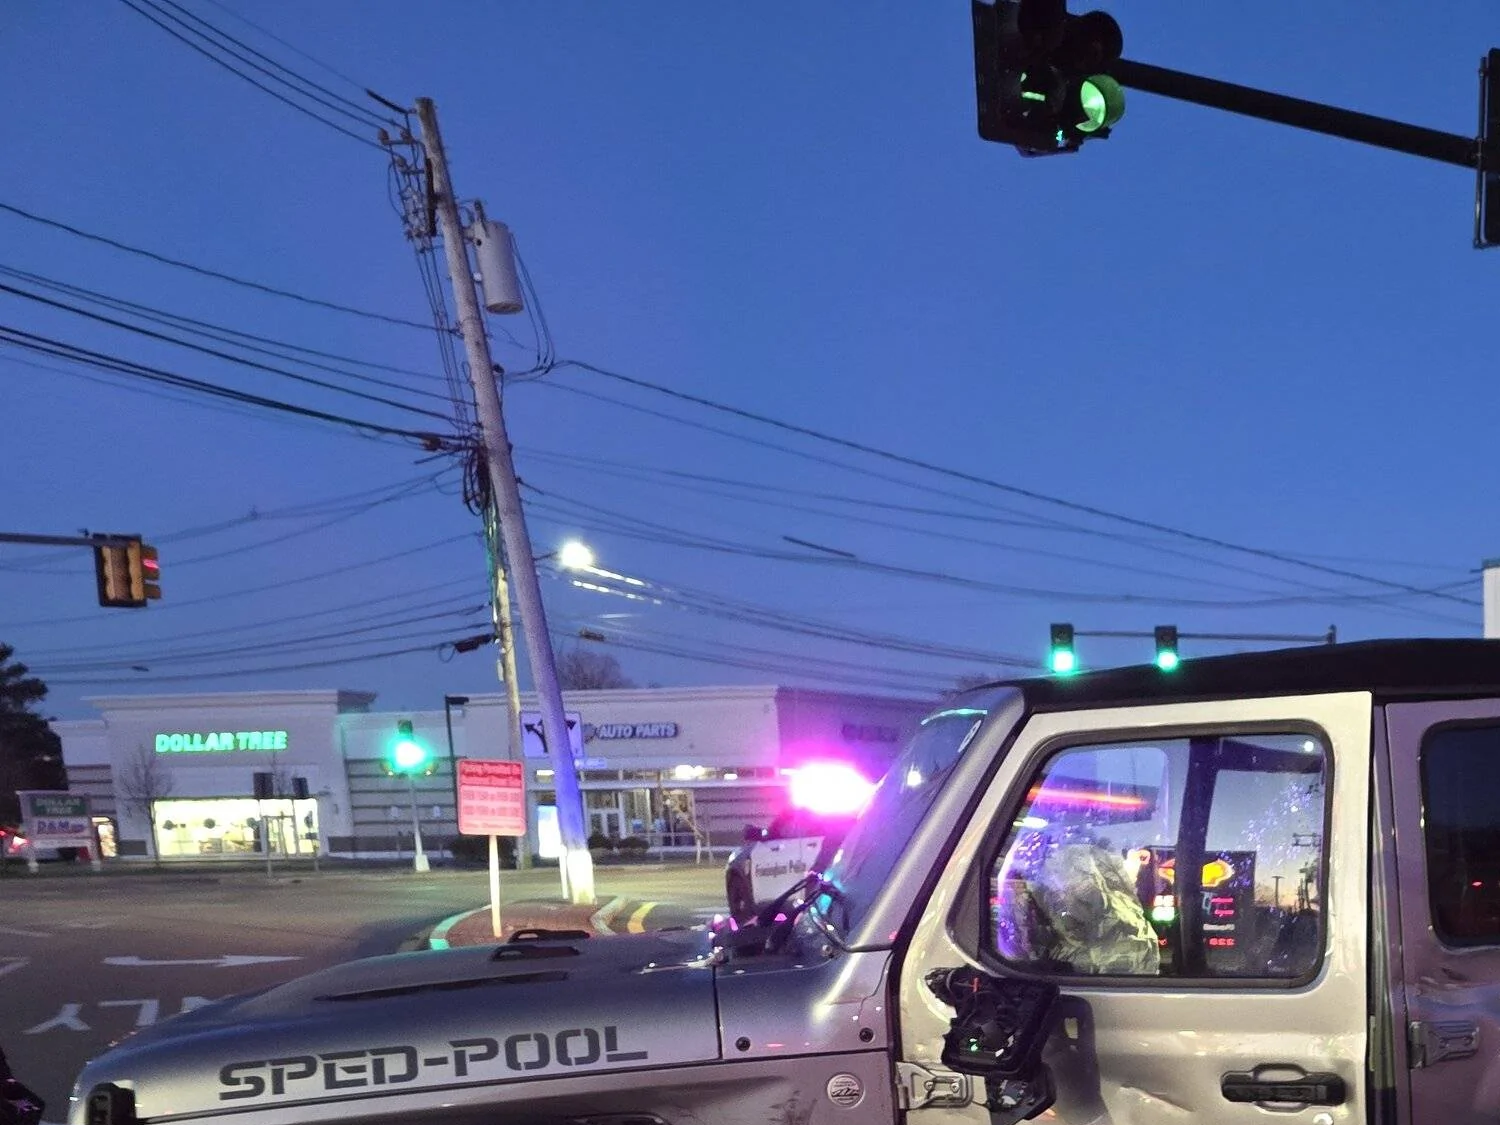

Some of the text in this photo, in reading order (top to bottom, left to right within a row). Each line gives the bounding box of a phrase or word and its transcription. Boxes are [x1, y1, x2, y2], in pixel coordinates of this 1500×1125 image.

[599, 723, 676, 738] AUTO PARTS
[155, 731, 288, 753] DOLLAR TREE
[218, 1026, 648, 1100] SPED-POOL
